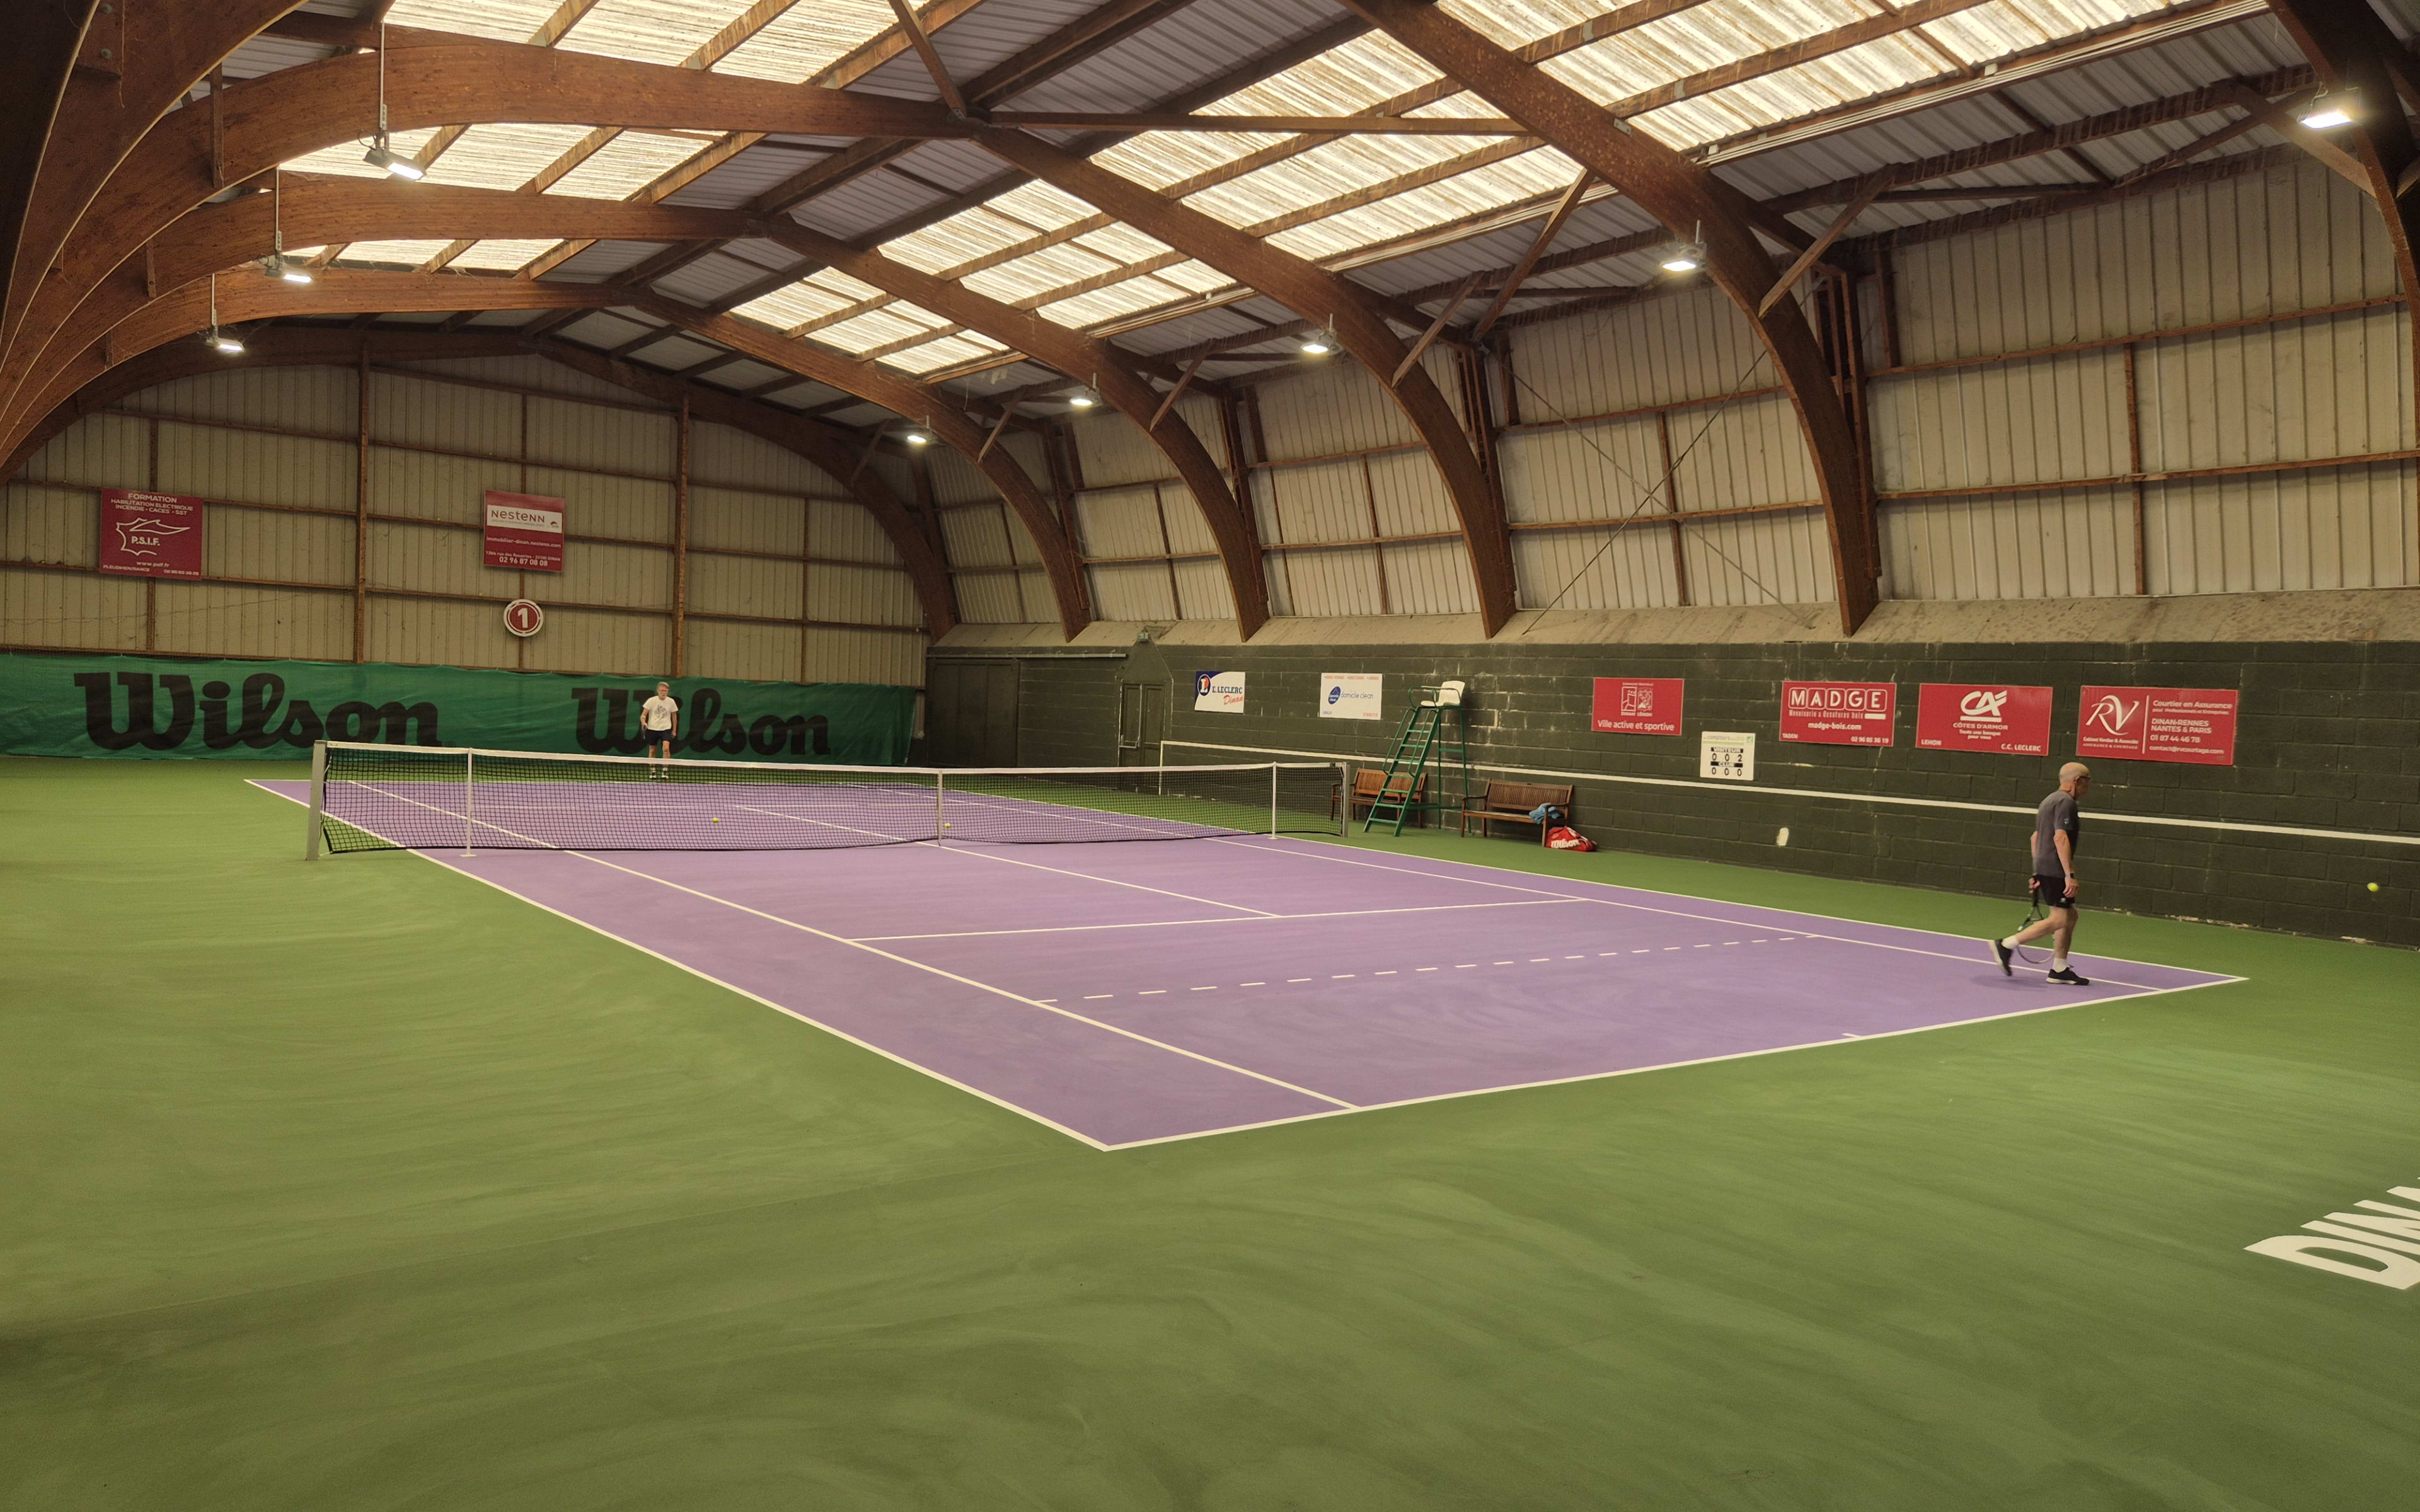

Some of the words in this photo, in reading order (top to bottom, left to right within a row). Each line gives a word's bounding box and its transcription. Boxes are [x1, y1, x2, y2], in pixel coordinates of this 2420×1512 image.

[128, 493, 177, 503] FORMATION
[111, 499, 154, 507] HABILITATION
[156, 503, 193, 511] ELECTRIQUE
[131, 536, 161, 546] P.S.I.F.
[518, 608, 528, 628] 1
[1223, 694, 1243, 706] Dinan
[1791, 690, 1881, 708] MADGE
[74, 672, 442, 750] Wilson
[2085, 695, 2140, 735] RV
[1598, 719, 1612, 728] Ville
[1613, 721, 1634, 729] active
[1644, 722, 1674, 731] sportive
[1808, 721, 1862, 731] madge-bois.com
[2152, 718, 2210, 727] DINAN-RENNES
[2149, 746, 2224, 755] contact@rvcourtage.com
[1712, 753, 1717, 761] 0
[1724, 753, 1729, 762] 0
[1737, 754, 1742, 762] 2
[1724, 768, 1729, 776] 0
[1551, 839, 1581, 849] Wilson
